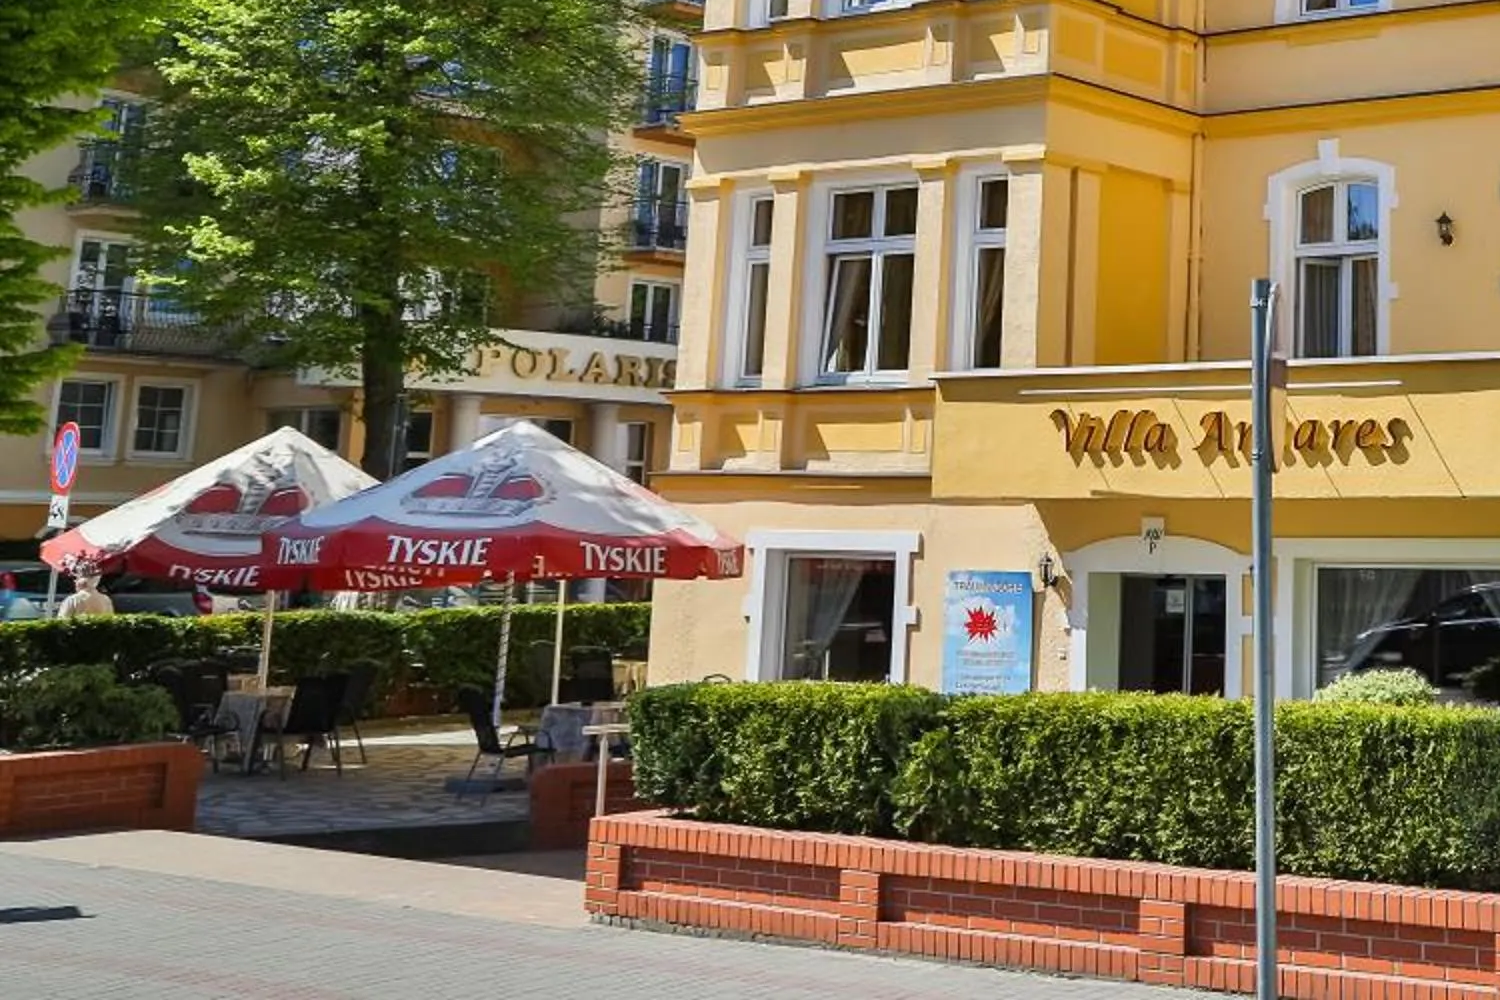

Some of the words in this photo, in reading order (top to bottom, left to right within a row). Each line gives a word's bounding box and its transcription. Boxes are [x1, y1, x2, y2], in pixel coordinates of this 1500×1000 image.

[1050, 409, 1165, 453] Villa
[277, 535, 325, 565] TYSKIE
[387, 535, 493, 565] TYSKIE
[580, 541, 667, 574] TYSKIE
